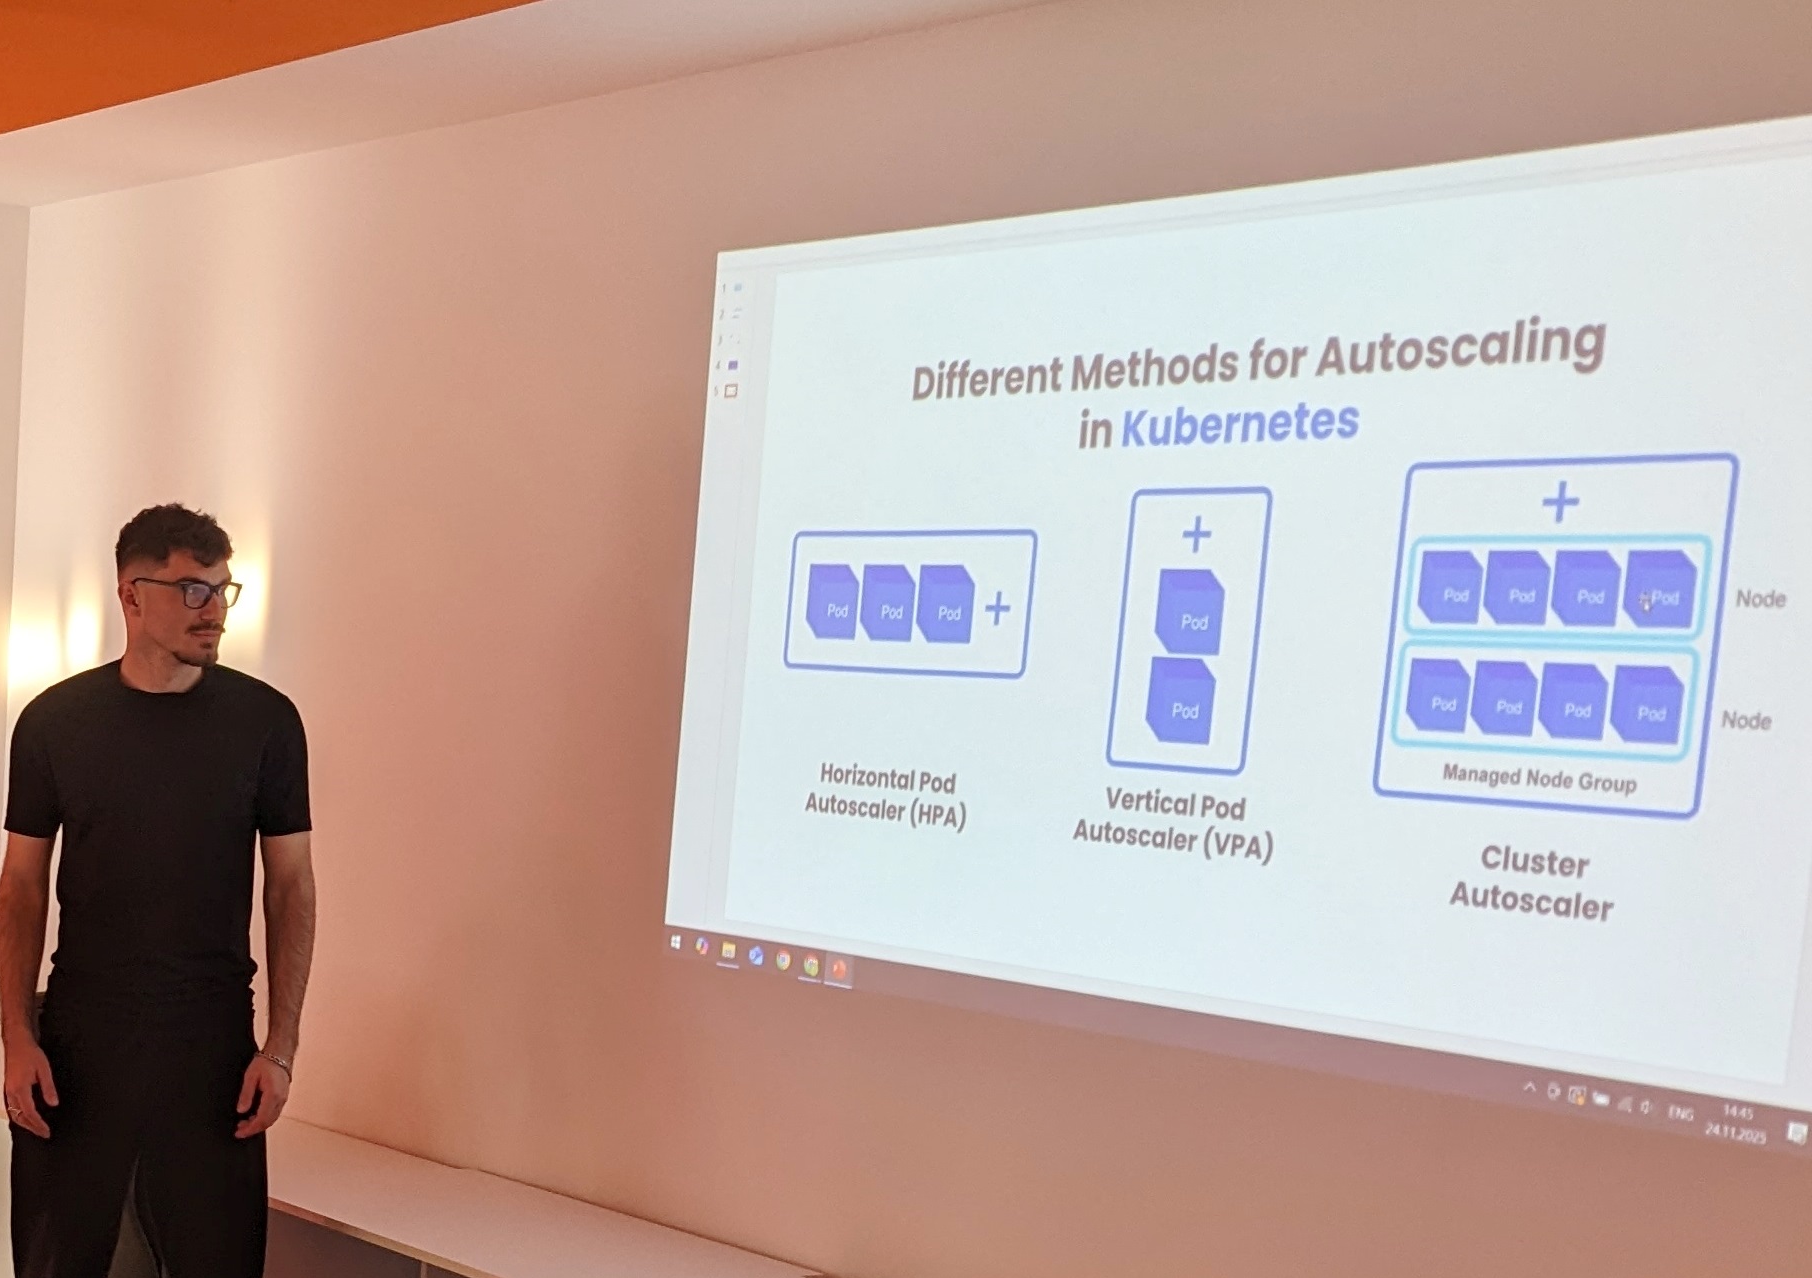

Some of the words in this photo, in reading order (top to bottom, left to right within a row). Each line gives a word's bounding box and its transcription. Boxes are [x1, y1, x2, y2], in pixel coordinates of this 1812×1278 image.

[912, 357, 1063, 401] Different
[1071, 343, 1239, 391] Methods
[1249, 337, 1308, 380] for
[1315, 315, 1607, 374] Autoscaling
[1079, 408, 1112, 449] in
[1122, 402, 1360, 448] Kubernetes
[827, 603, 849, 618] Pod
[881, 604, 904, 619] Pod
[938, 605, 961, 621] Pod
[1444, 587, 1470, 602] Pod
[1509, 588, 1536, 603] Pod
[1577, 589, 1606, 605] Pod
[1651, 590, 1680, 606] Pod
[1736, 589, 1788, 609] Node
[1181, 613, 1209, 631] Pod
[1172, 702, 1200, 719] Pod
[1431, 696, 1458, 712] Pod
[1496, 699, 1523, 715] Pod
[1564, 703, 1593, 719] Pod
[1638, 705, 1667, 722] Pod
[1721, 710, 1773, 731] Node
[820, 762, 916, 791] Horizontal
[919, 771, 957, 795] Pod
[1443, 763, 1522, 788] Managed
[1526, 768, 1574, 789] Node
[1579, 771, 1638, 797] Group
[805, 792, 906, 822] Autoscaler
[910, 797, 967, 834] (HPA)
[1106, 786, 1197, 817] Vertical
[1201, 795, 1247, 821] Pod
[1072, 818, 1198, 852] Autoscaler
[1204, 825, 1274, 866] (VPA)
[1481, 844, 1590, 879] Cluster
[1449, 881, 1615, 922] Autoscaler
[1668, 1104, 1695, 1122] ENG
